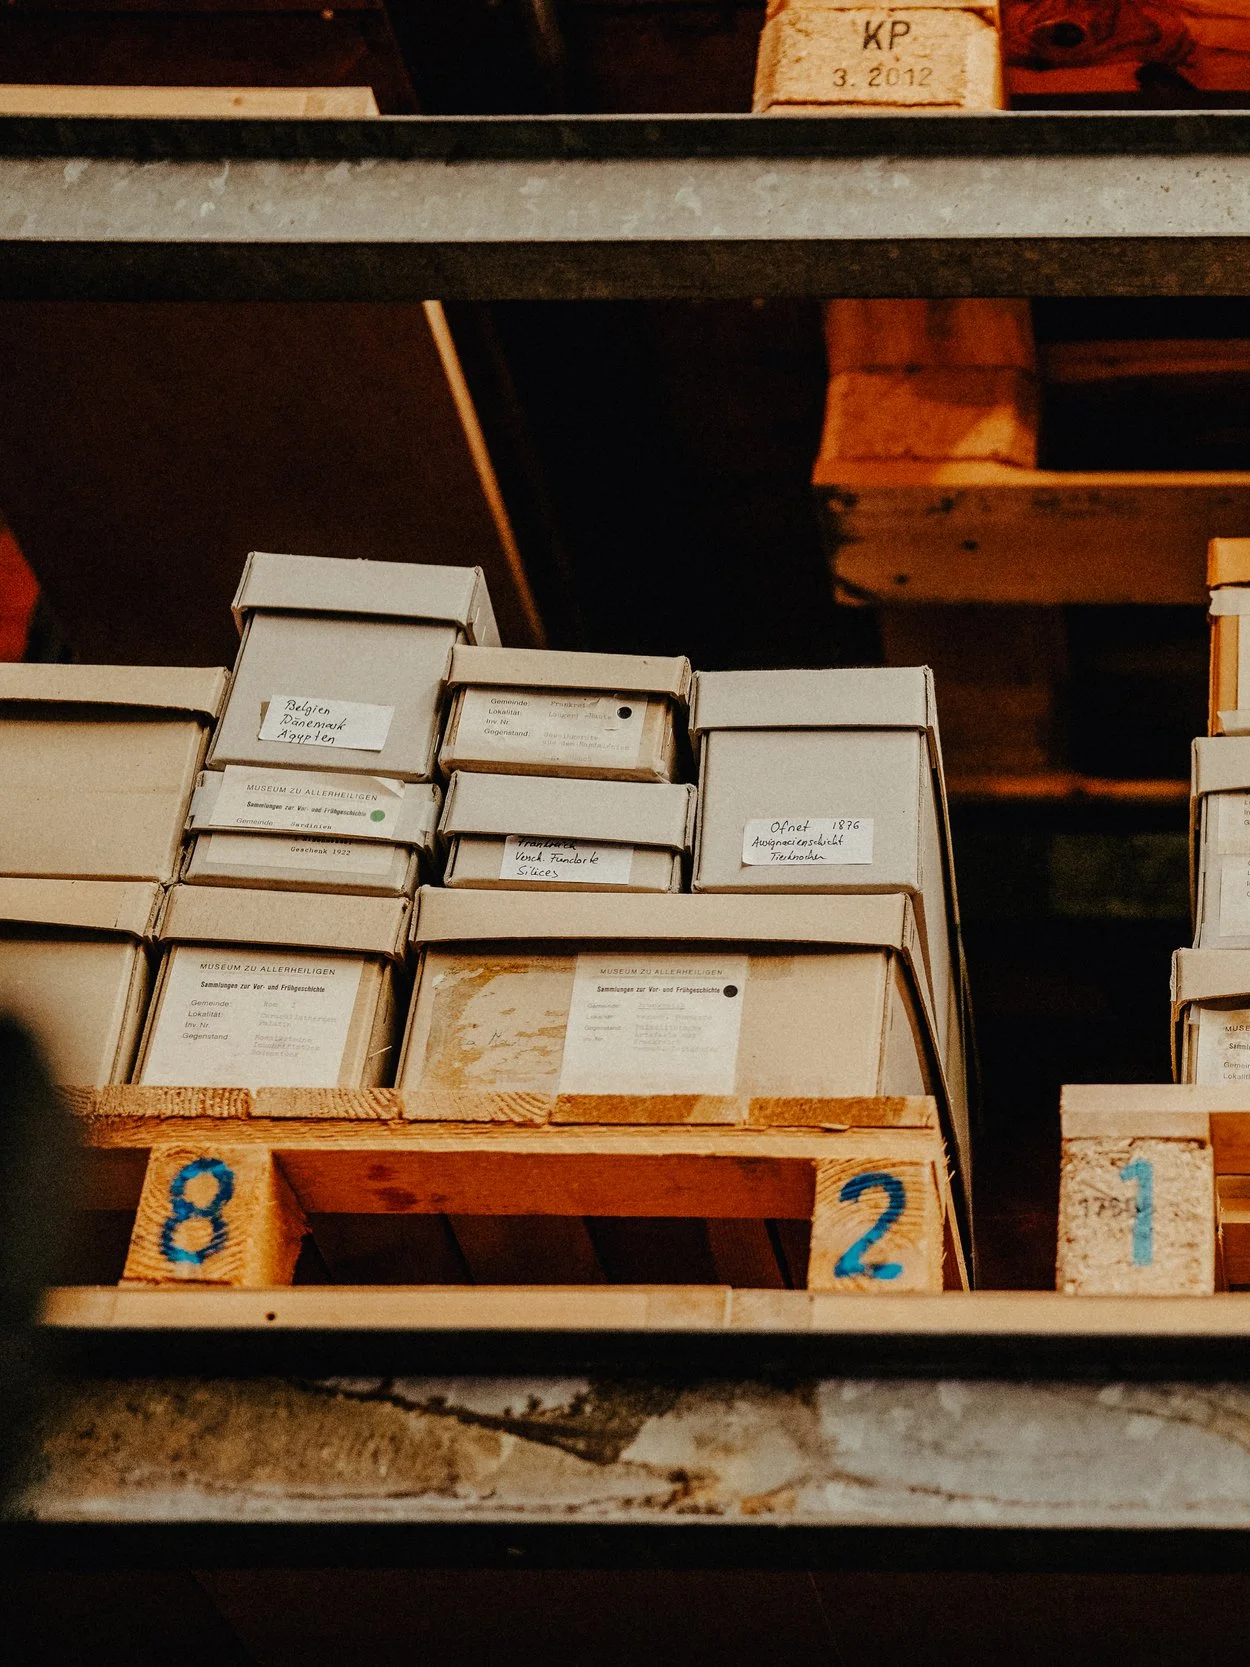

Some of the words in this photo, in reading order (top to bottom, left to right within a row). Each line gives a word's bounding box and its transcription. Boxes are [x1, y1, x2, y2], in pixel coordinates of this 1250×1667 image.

[863, 20, 911, 50] KP
[868, 67, 934, 87] 2012
[285, 699, 330, 716] Belgien
[280, 714, 347, 731] Dänemark
[277, 727, 336, 744] Ägypten
[246, 784, 287, 794] MUSEUM
[304, 788, 378, 801] ALLERHEILIGEN
[246, 801, 283, 810] Sammlungen
[323, 808, 367, 817] Frühgeschichte
[770, 820, 812, 834] Ofnet
[832, 820, 860, 830] 1876
[290, 846, 328, 855] Geschenk
[332, 848, 351, 856] 1922
[771, 850, 826, 861] Tierknochen
[550, 852, 599, 865] Fundorte
[516, 866, 559, 878] Silices
[200, 963, 241, 971] MUSEUM
[260, 966, 336, 976] ALLERHEILIGEN
[200, 981, 238, 990] Sammlungen
[281, 985, 325, 993] Frühgeschichte
[597, 986, 634, 994] Sammlungen
[676, 986, 720, 994] Frühgeschichte
[191, 1000, 232, 1008] Gemeinde:
[188, 1010, 224, 1018] Lokalität:
[183, 1033, 231, 1041] Gegenstand:
[160, 1156, 234, 1263] 8
[1119, 1157, 1154, 1268] 1
[832, 1170, 908, 1281] 2
